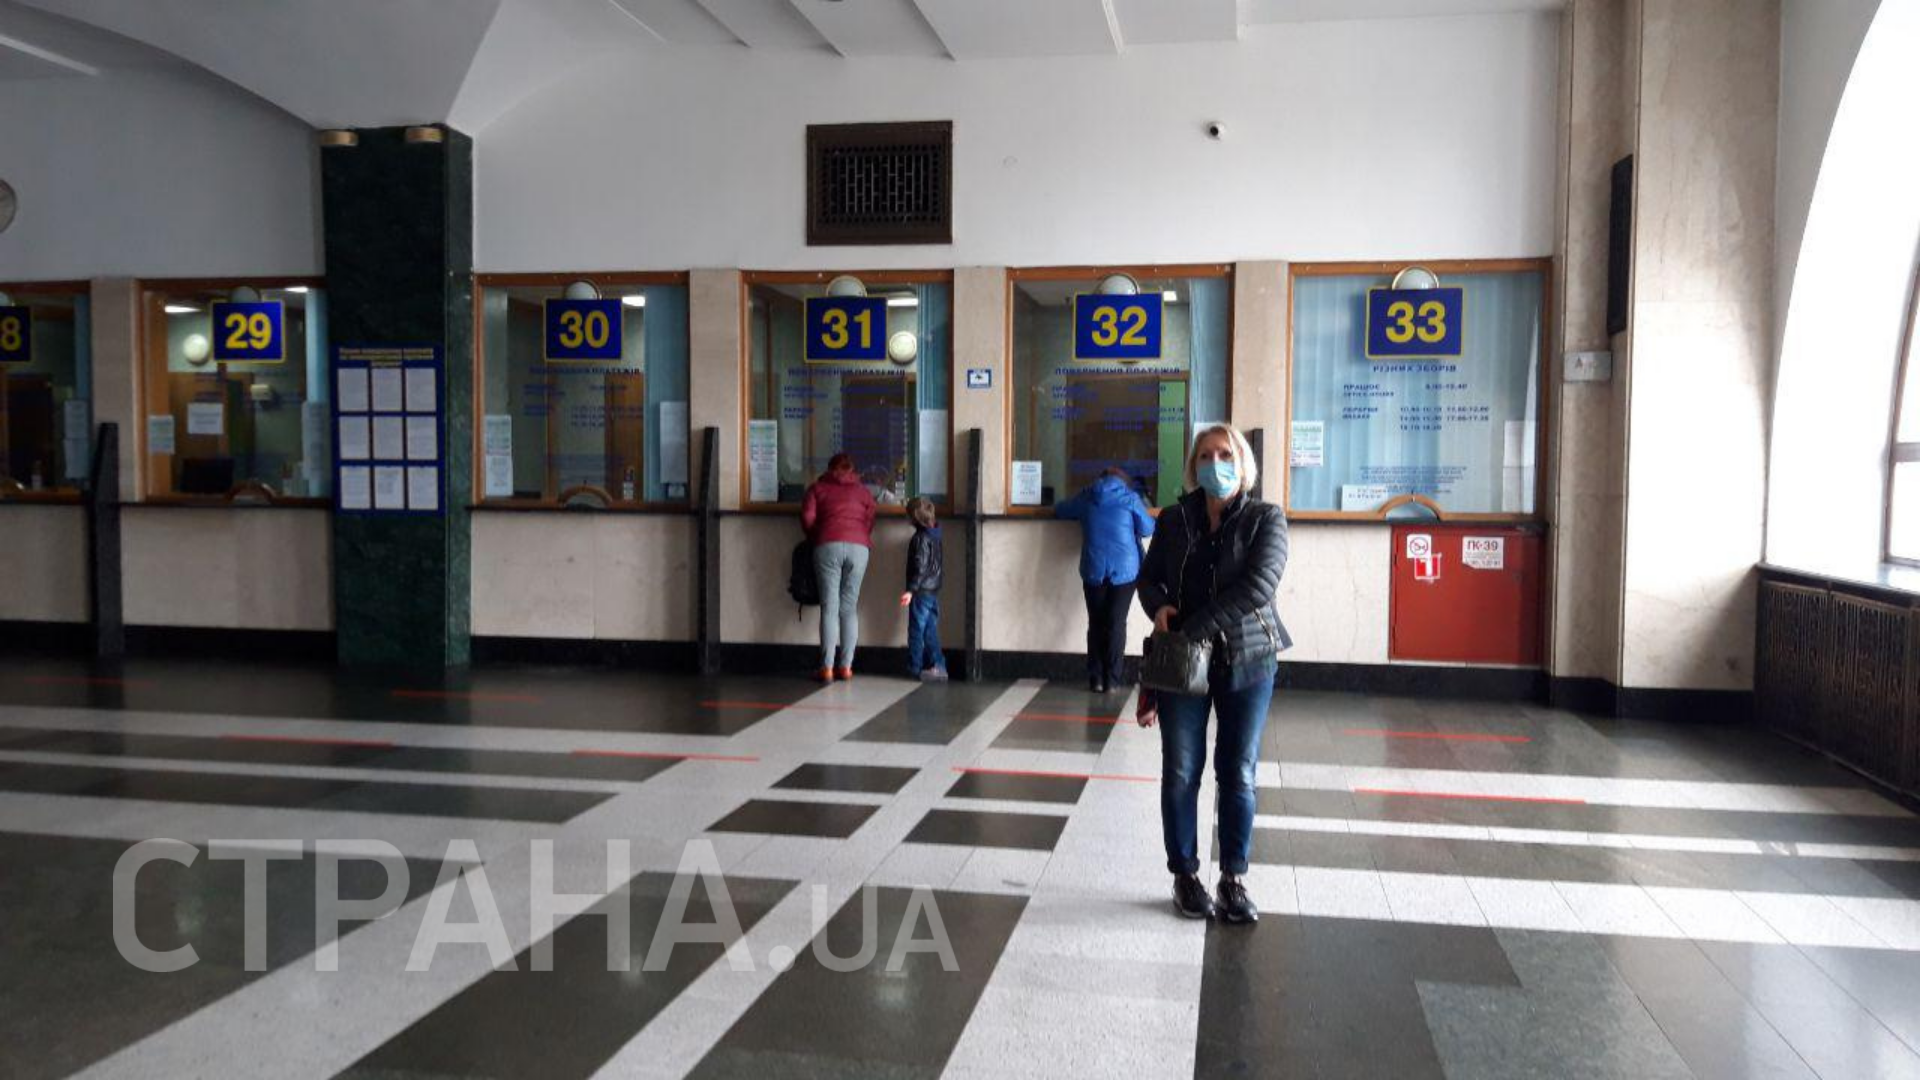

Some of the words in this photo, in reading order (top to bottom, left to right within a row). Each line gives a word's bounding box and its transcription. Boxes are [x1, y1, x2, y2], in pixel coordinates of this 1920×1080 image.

[0, 316, 22, 351] 8
[225, 313, 272, 349] 29
[558, 310, 610, 348] 30
[821, 309, 872, 349] 31
[1091, 306, 1147, 346] 32
[1386, 302, 1446, 342] 33
[1416, 364, 1457, 373] ЗБОРІВ
[1467, 539, 1498, 551] ПК-39
